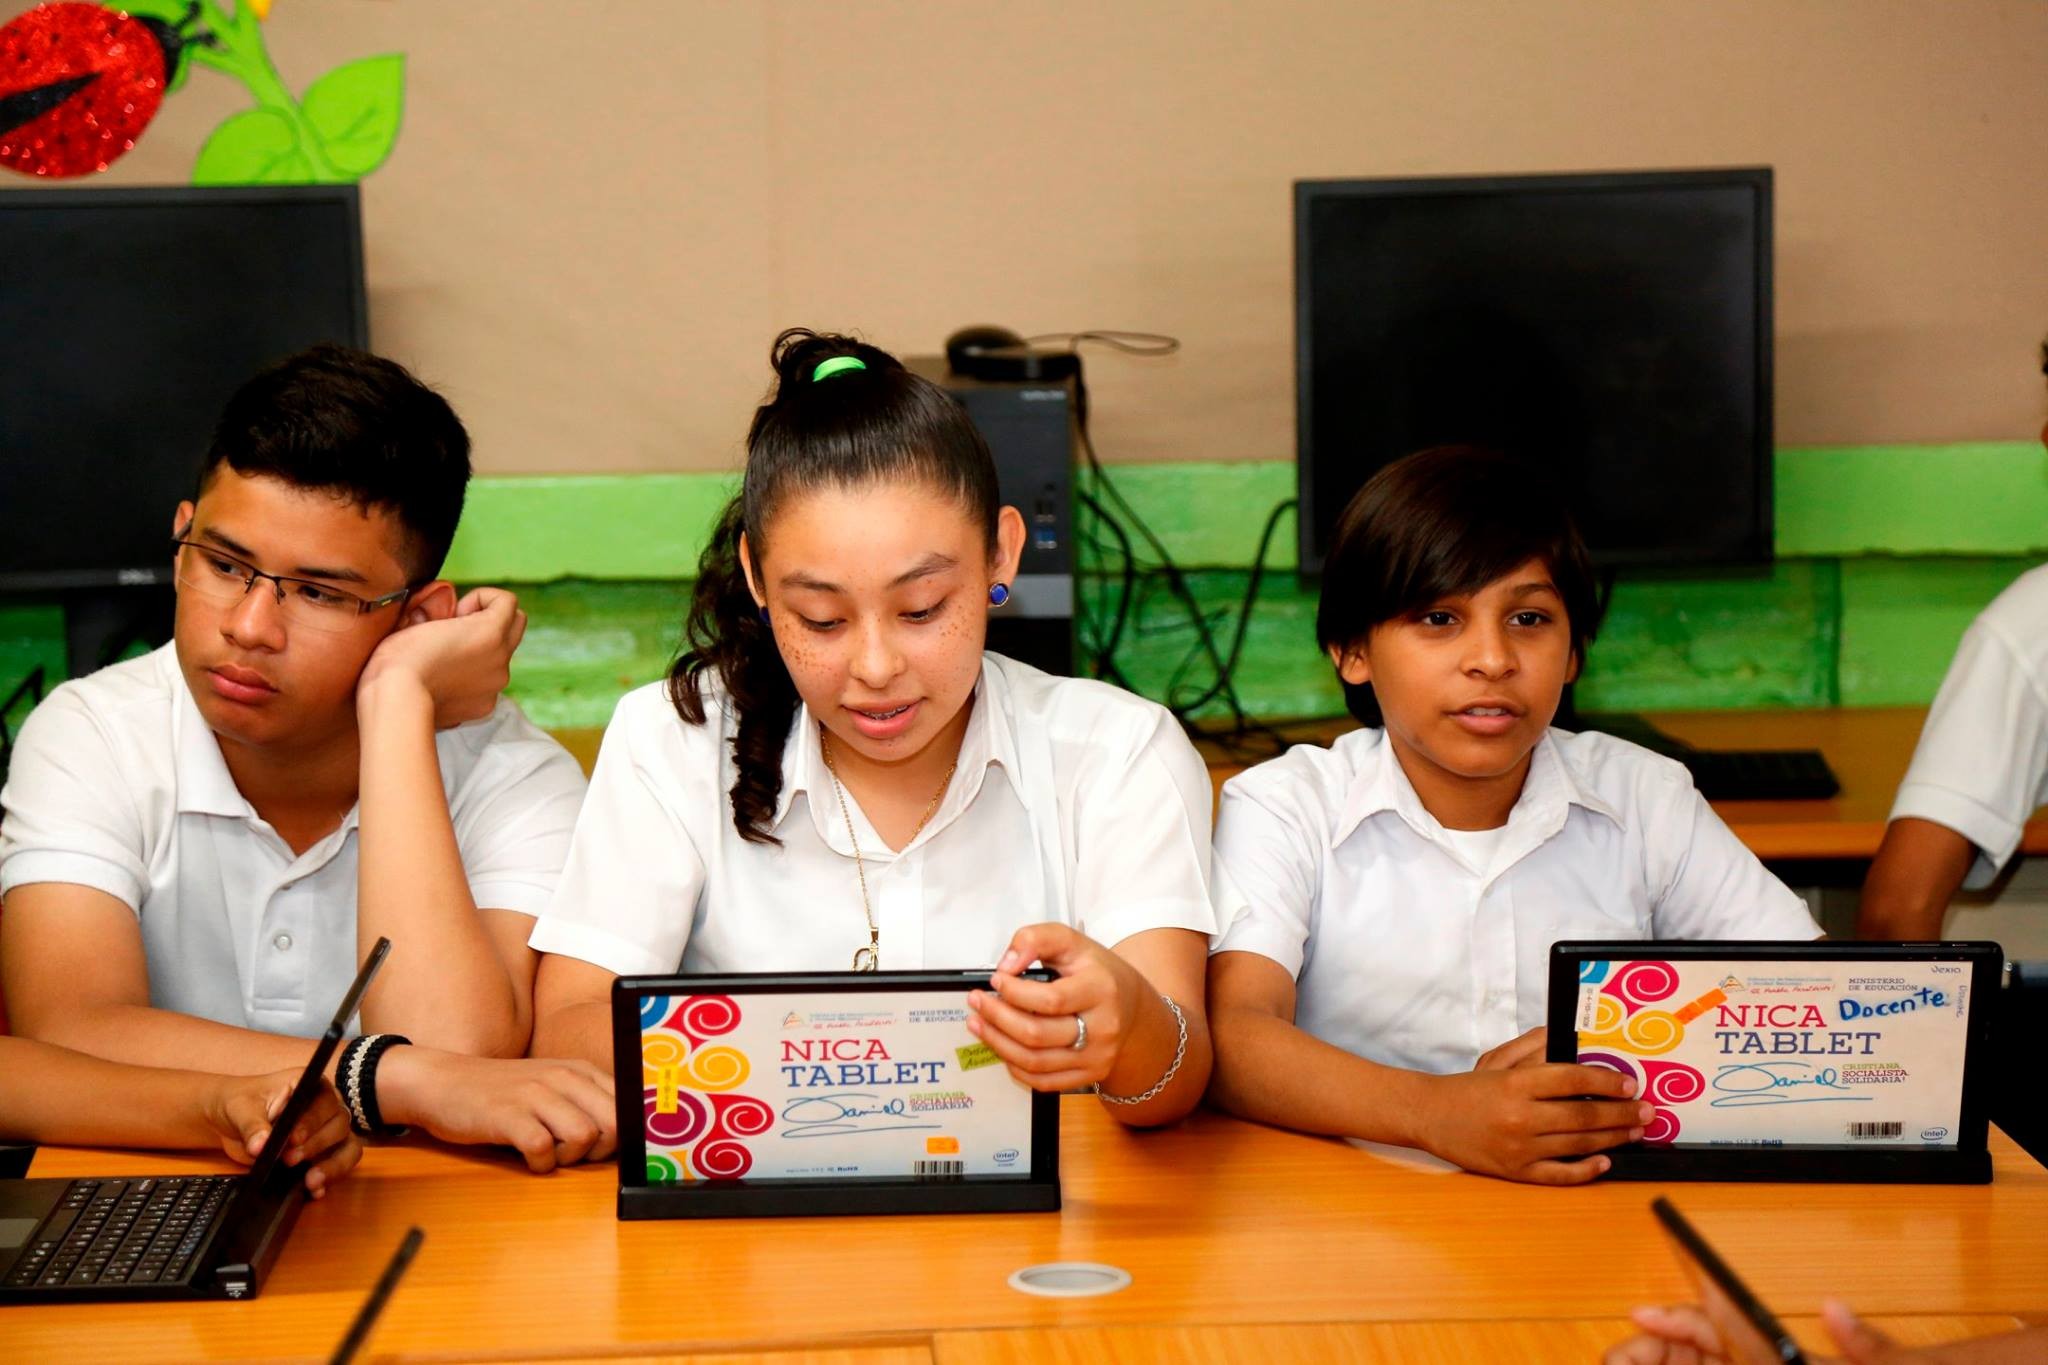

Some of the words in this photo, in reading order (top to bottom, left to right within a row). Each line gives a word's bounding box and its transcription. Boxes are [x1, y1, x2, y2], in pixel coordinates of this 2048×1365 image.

[1715, 1004, 1827, 1028] NICA
[1839, 987, 1946, 1021] Docente
[780, 1038, 892, 1062] NICA
[1714, 1031, 1881, 1055] TABLET
[781, 1061, 945, 1088] TABLET
